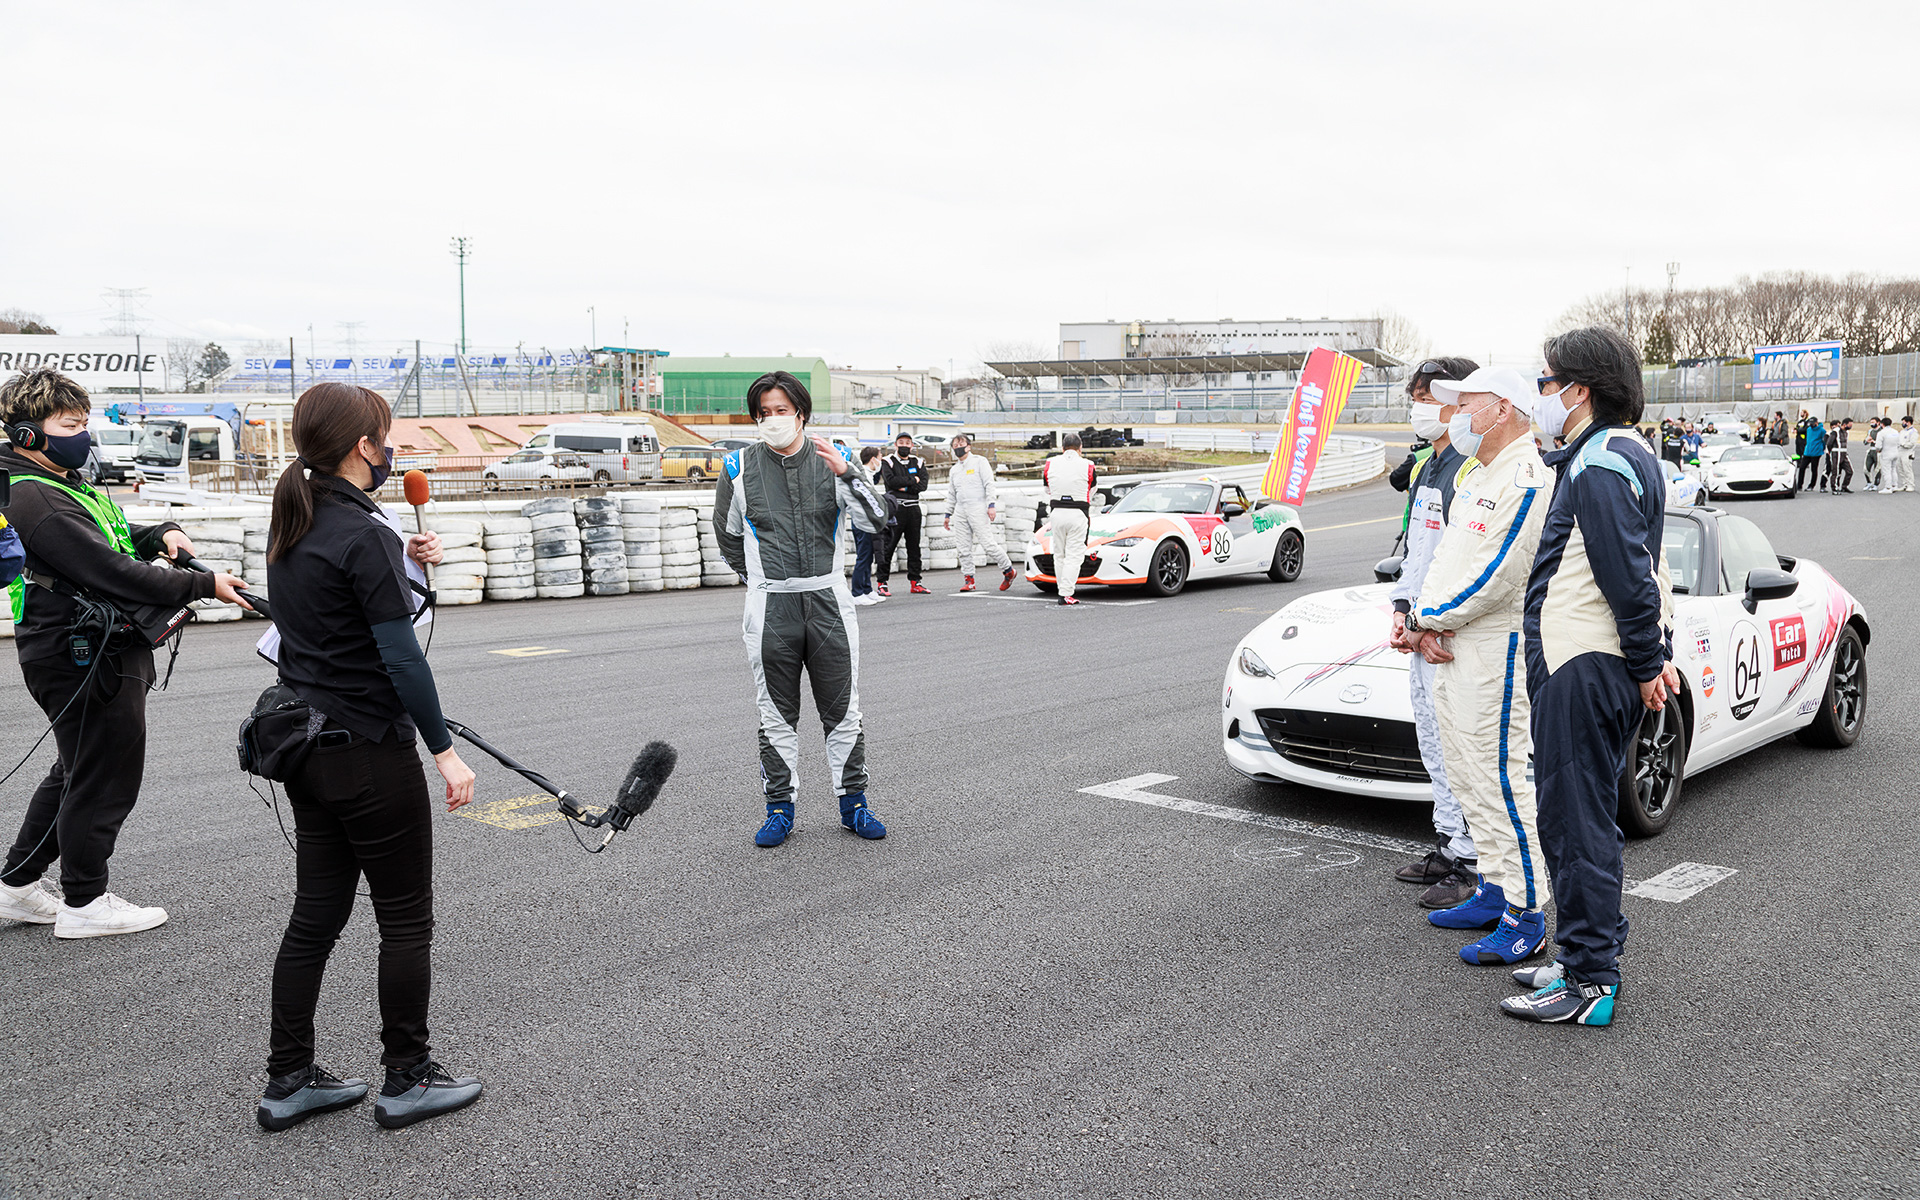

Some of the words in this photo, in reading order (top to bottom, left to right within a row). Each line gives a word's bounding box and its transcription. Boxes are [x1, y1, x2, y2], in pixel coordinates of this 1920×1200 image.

[244, 359, 273, 370] SEV
[305, 359, 332, 370] SEV
[362, 358, 388, 369] SEV
[468, 357, 491, 368] SEV
[1759, 350, 1833, 381] WAKO'S
[1297, 382, 1324, 427] Hot
[1214, 530, 1231, 556] 86
[1774, 622, 1802, 647] Car
[1781, 645, 1801, 663] Watch
[1735, 635, 1762, 701] 64
[1702, 676, 1716, 689] Gulf
